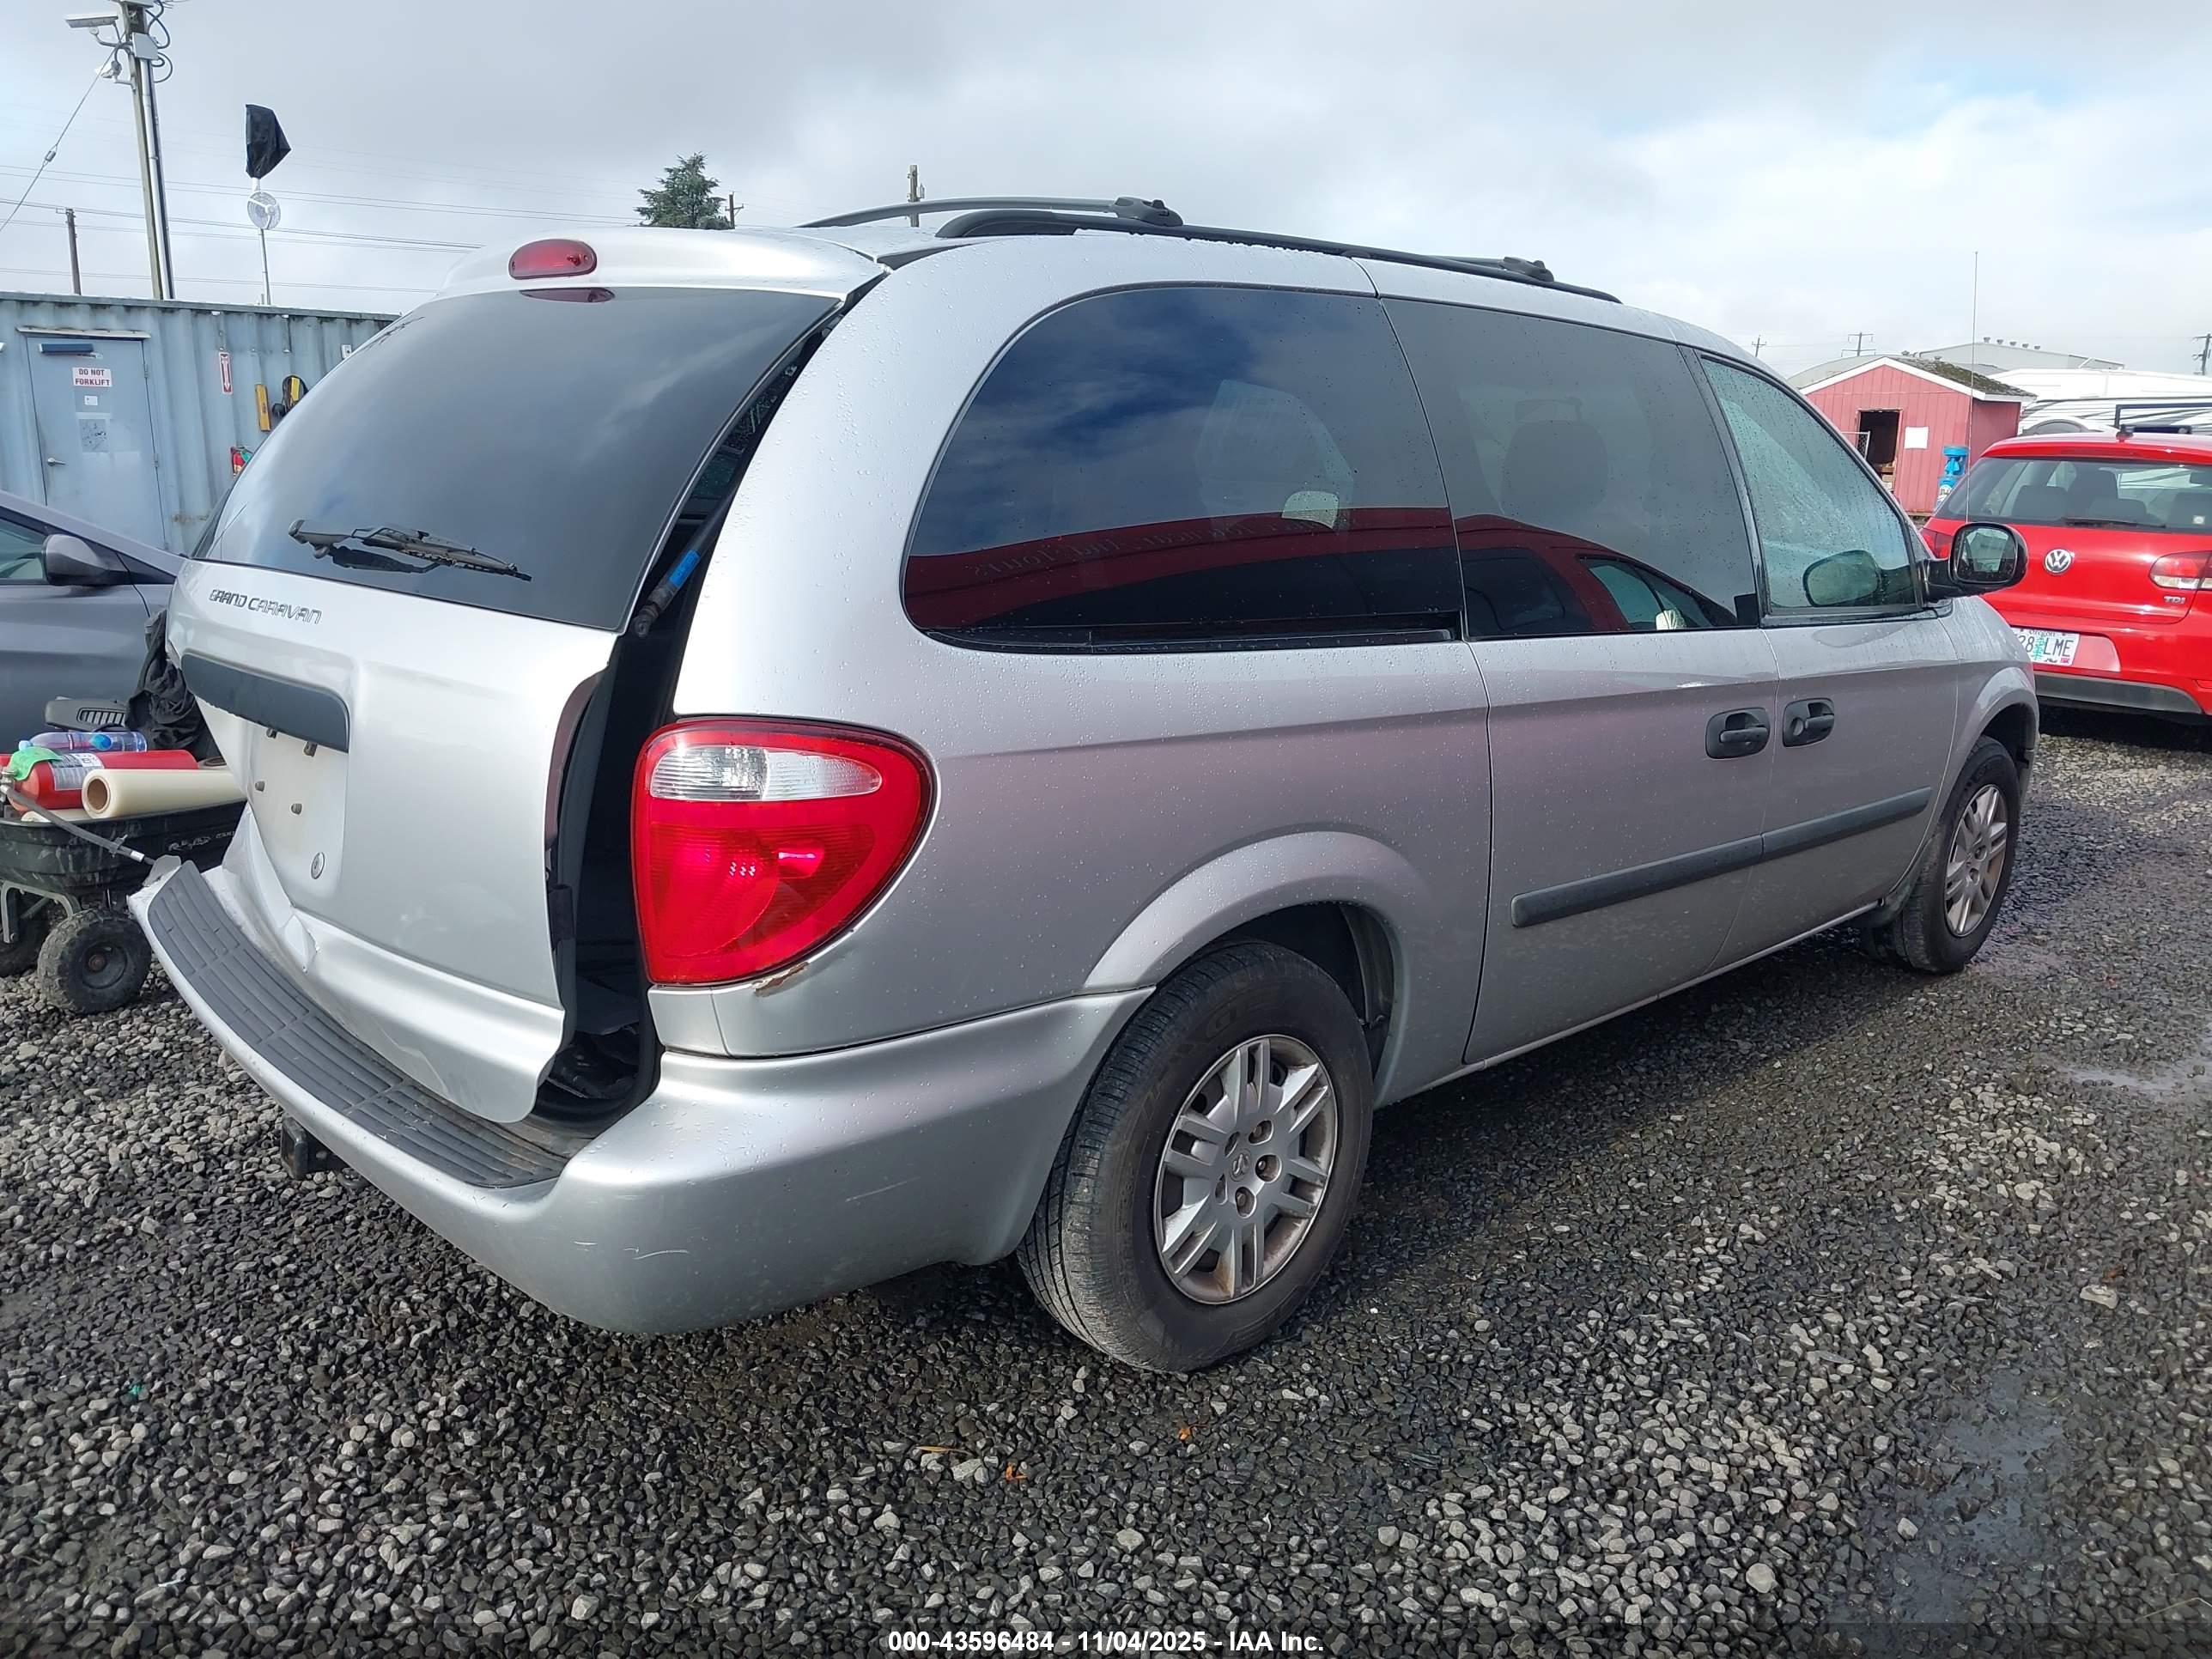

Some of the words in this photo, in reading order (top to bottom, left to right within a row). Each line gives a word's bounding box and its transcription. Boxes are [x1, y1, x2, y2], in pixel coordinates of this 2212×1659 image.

[78, 368, 89, 376] DO
[75, 378, 111, 386] FORKLIFT
[209, 588, 248, 608] GRAND
[248, 597, 323, 624] CARAVAN
[2043, 637, 2075, 658] LME
